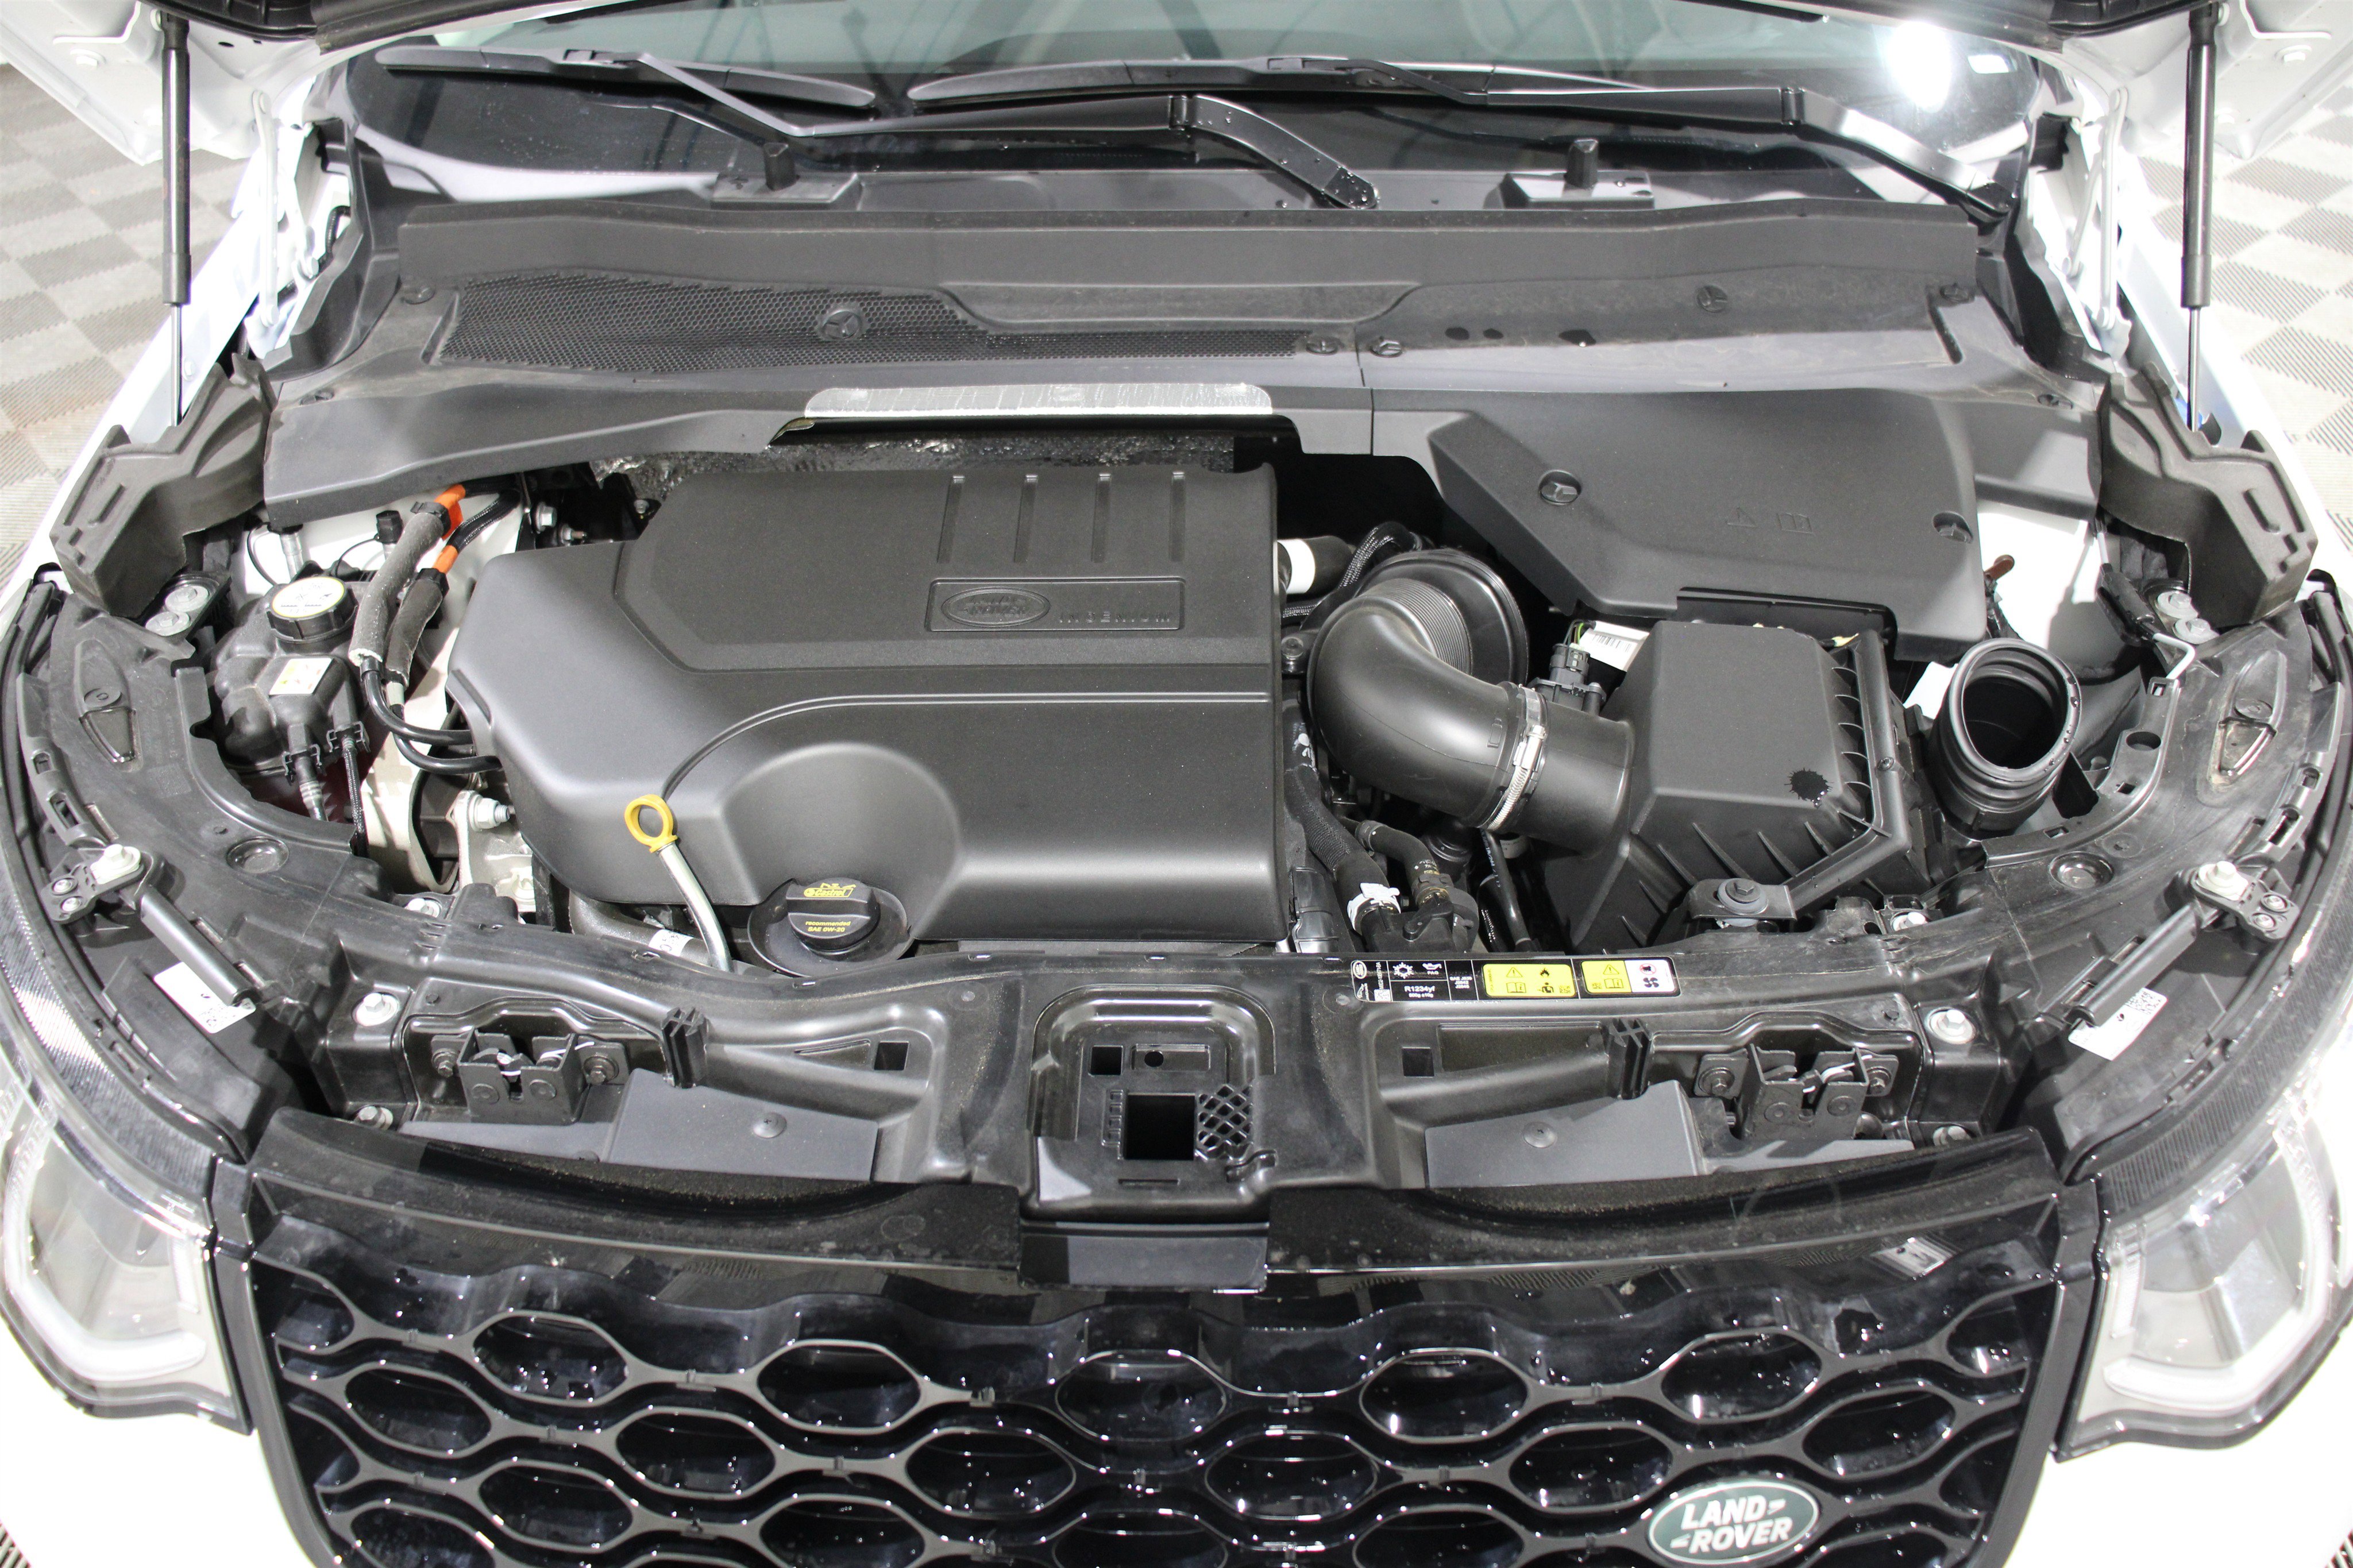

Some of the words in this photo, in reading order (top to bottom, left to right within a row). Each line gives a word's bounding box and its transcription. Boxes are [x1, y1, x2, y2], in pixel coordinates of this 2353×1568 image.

[815, 889, 846, 897] Castrol
[1404, 985, 1436, 994] R1234yf
[1680, 1494, 1767, 1531] LAND
[1688, 1516, 1793, 1554] ROVER
